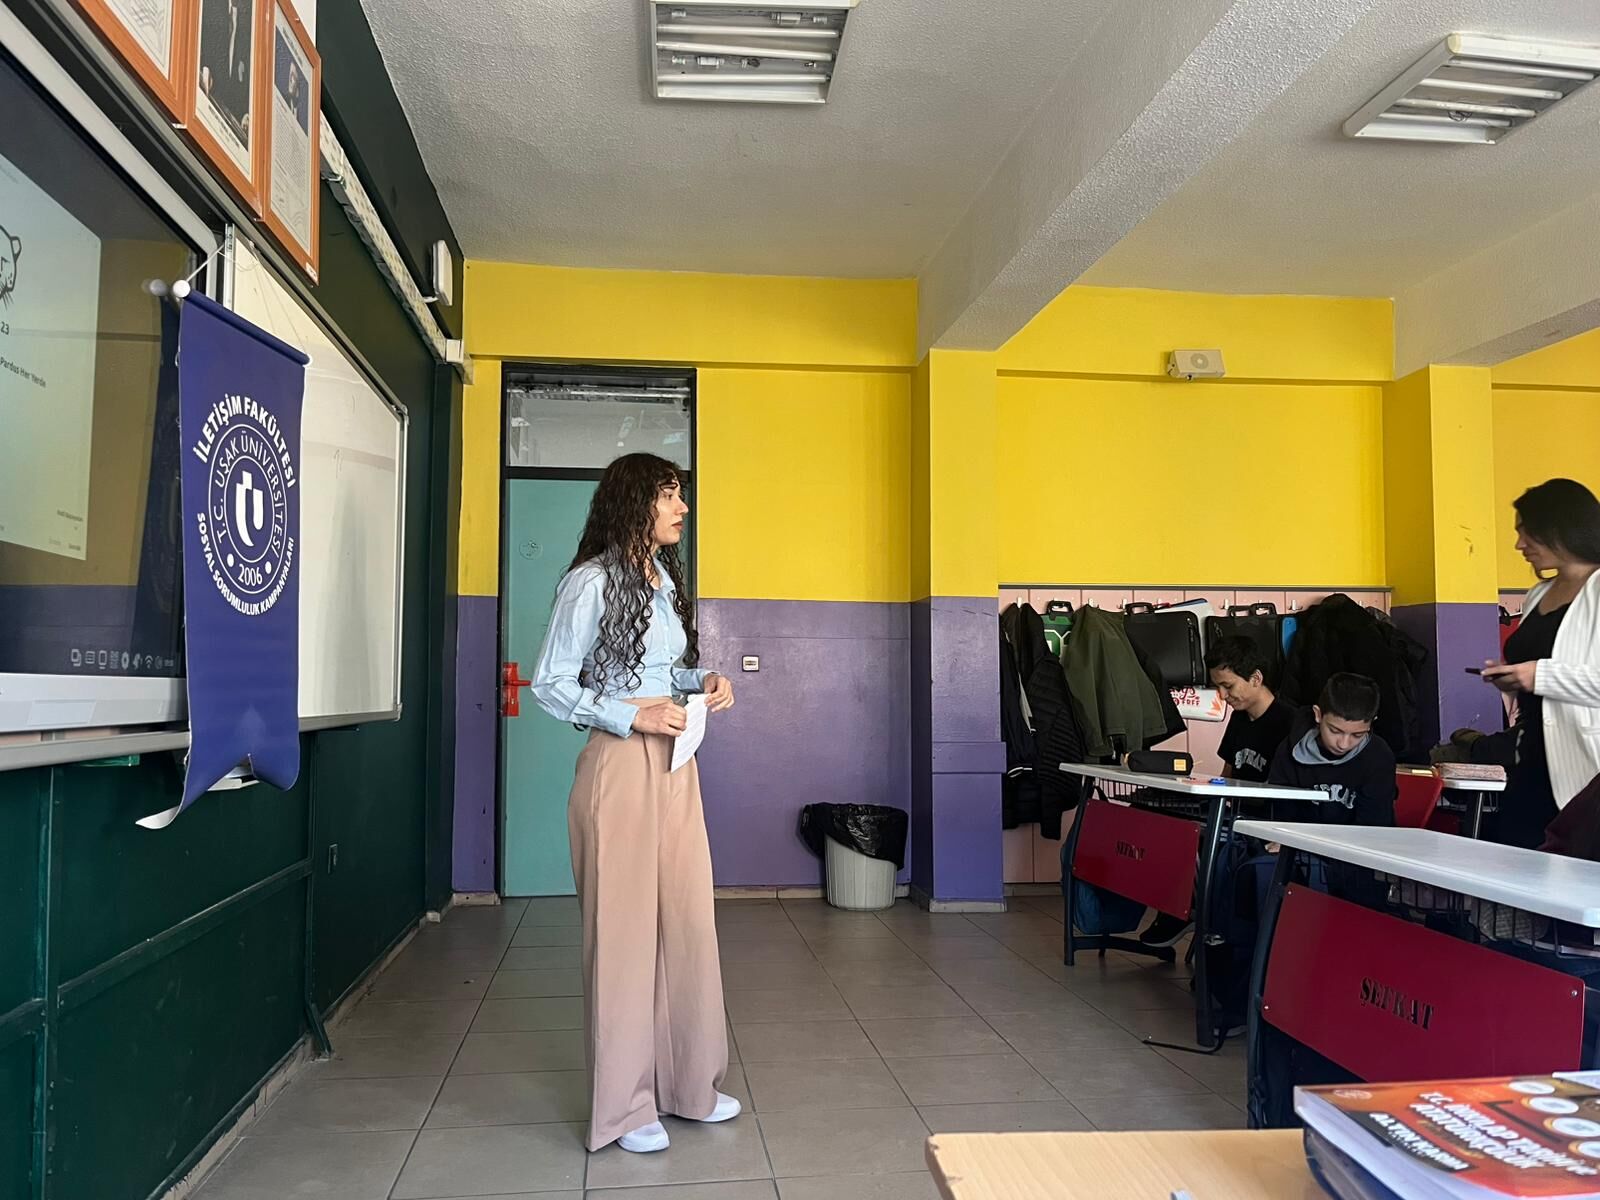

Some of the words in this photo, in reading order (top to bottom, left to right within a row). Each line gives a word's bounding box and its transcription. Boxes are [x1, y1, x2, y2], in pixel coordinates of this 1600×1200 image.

[0, 356, 20, 375] Pardus
[19, 367, 31, 380] Her
[30, 374, 47, 389] Yerde
[192, 393, 243, 464] İLETİŞİM
[214, 437, 240, 488] UŞAK
[213, 498, 227, 544] T.C.
[197, 512, 215, 573] SOSYAL
[213, 569, 261, 616] SORUMLULUK
[260, 536, 294, 614] KAMPANYALARI
[238, 563, 263, 587] 2006
[1360, 976, 1435, 1031] ŞEFKAT
